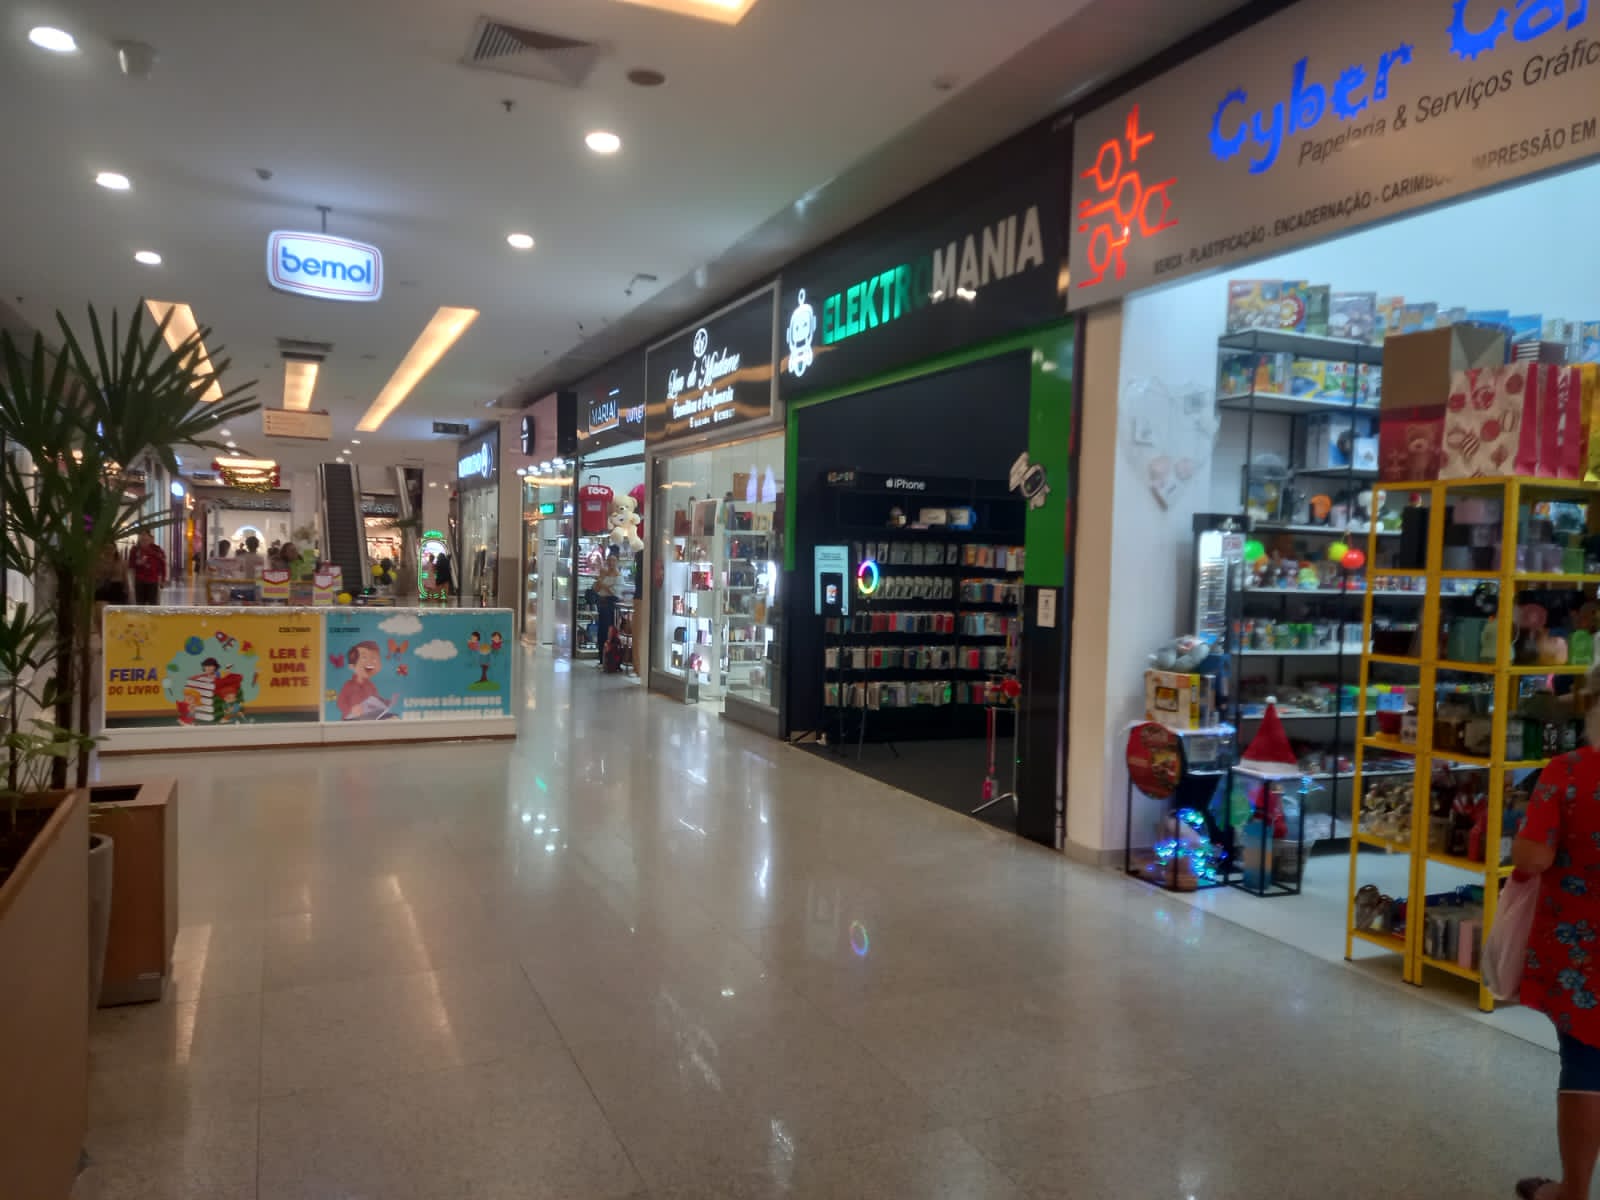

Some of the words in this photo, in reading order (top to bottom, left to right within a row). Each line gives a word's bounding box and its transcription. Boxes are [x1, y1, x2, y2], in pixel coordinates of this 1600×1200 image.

[1393, 104, 1407, 131] &
[1415, 69, 1513, 123] Serviços
[1208, 42, 1414, 175] Cyber
[1189, 226, 1266, 264] PLASTIFICAÇÃO
[1274, 191, 1371, 236] ENCADERNAÇÃO
[1570, 117, 1597, 144] EM
[281, 246, 371, 284] bemol
[822, 205, 1044, 345] ELEKTROMANIA
[893, 478, 926, 491] iPhone
[269, 647, 297, 659] LER
[109, 667, 158, 682] FEIRA
[272, 662, 306, 673] UMA
[270, 676, 310, 687] ARTE
[108, 685, 123, 695] DO
[127, 685, 159, 695] LIVRO
